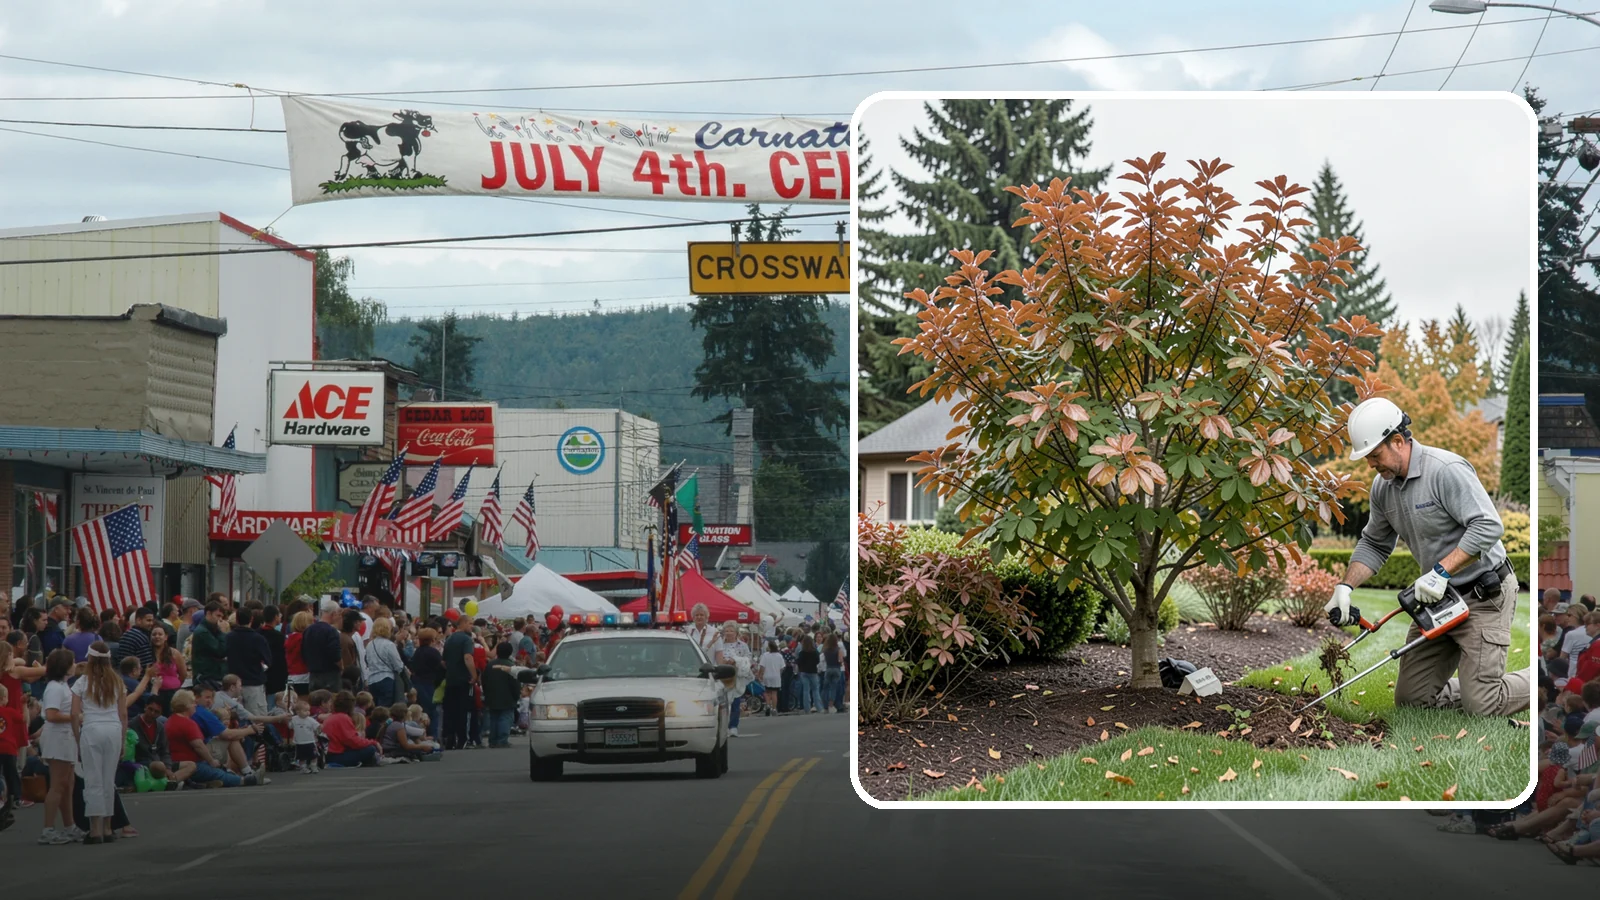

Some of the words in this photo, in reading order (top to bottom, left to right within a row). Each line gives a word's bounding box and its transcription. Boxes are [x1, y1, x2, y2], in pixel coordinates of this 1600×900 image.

[695, 121, 850, 150] Carnat
[481, 141, 604, 192] JULY
[632, 150, 746, 198] 4th.
[697, 254, 850, 280] CROSSWA
[283, 380, 373, 420] ACE
[405, 409, 452, 422] CEDAR
[283, 421, 370, 436] Hardware
[416, 428, 477, 447] Coca-Cola
[353, 467, 386, 480] Simpl
[83, 485, 93, 494] St.
[96, 485, 124, 494] Vincent
[126, 486, 136, 494] de
[138, 486, 155, 495] Paul
[212, 515, 331, 535] HARDARE
[688, 527, 741, 535] CRNATION
[699, 535, 730, 543] GLASS
